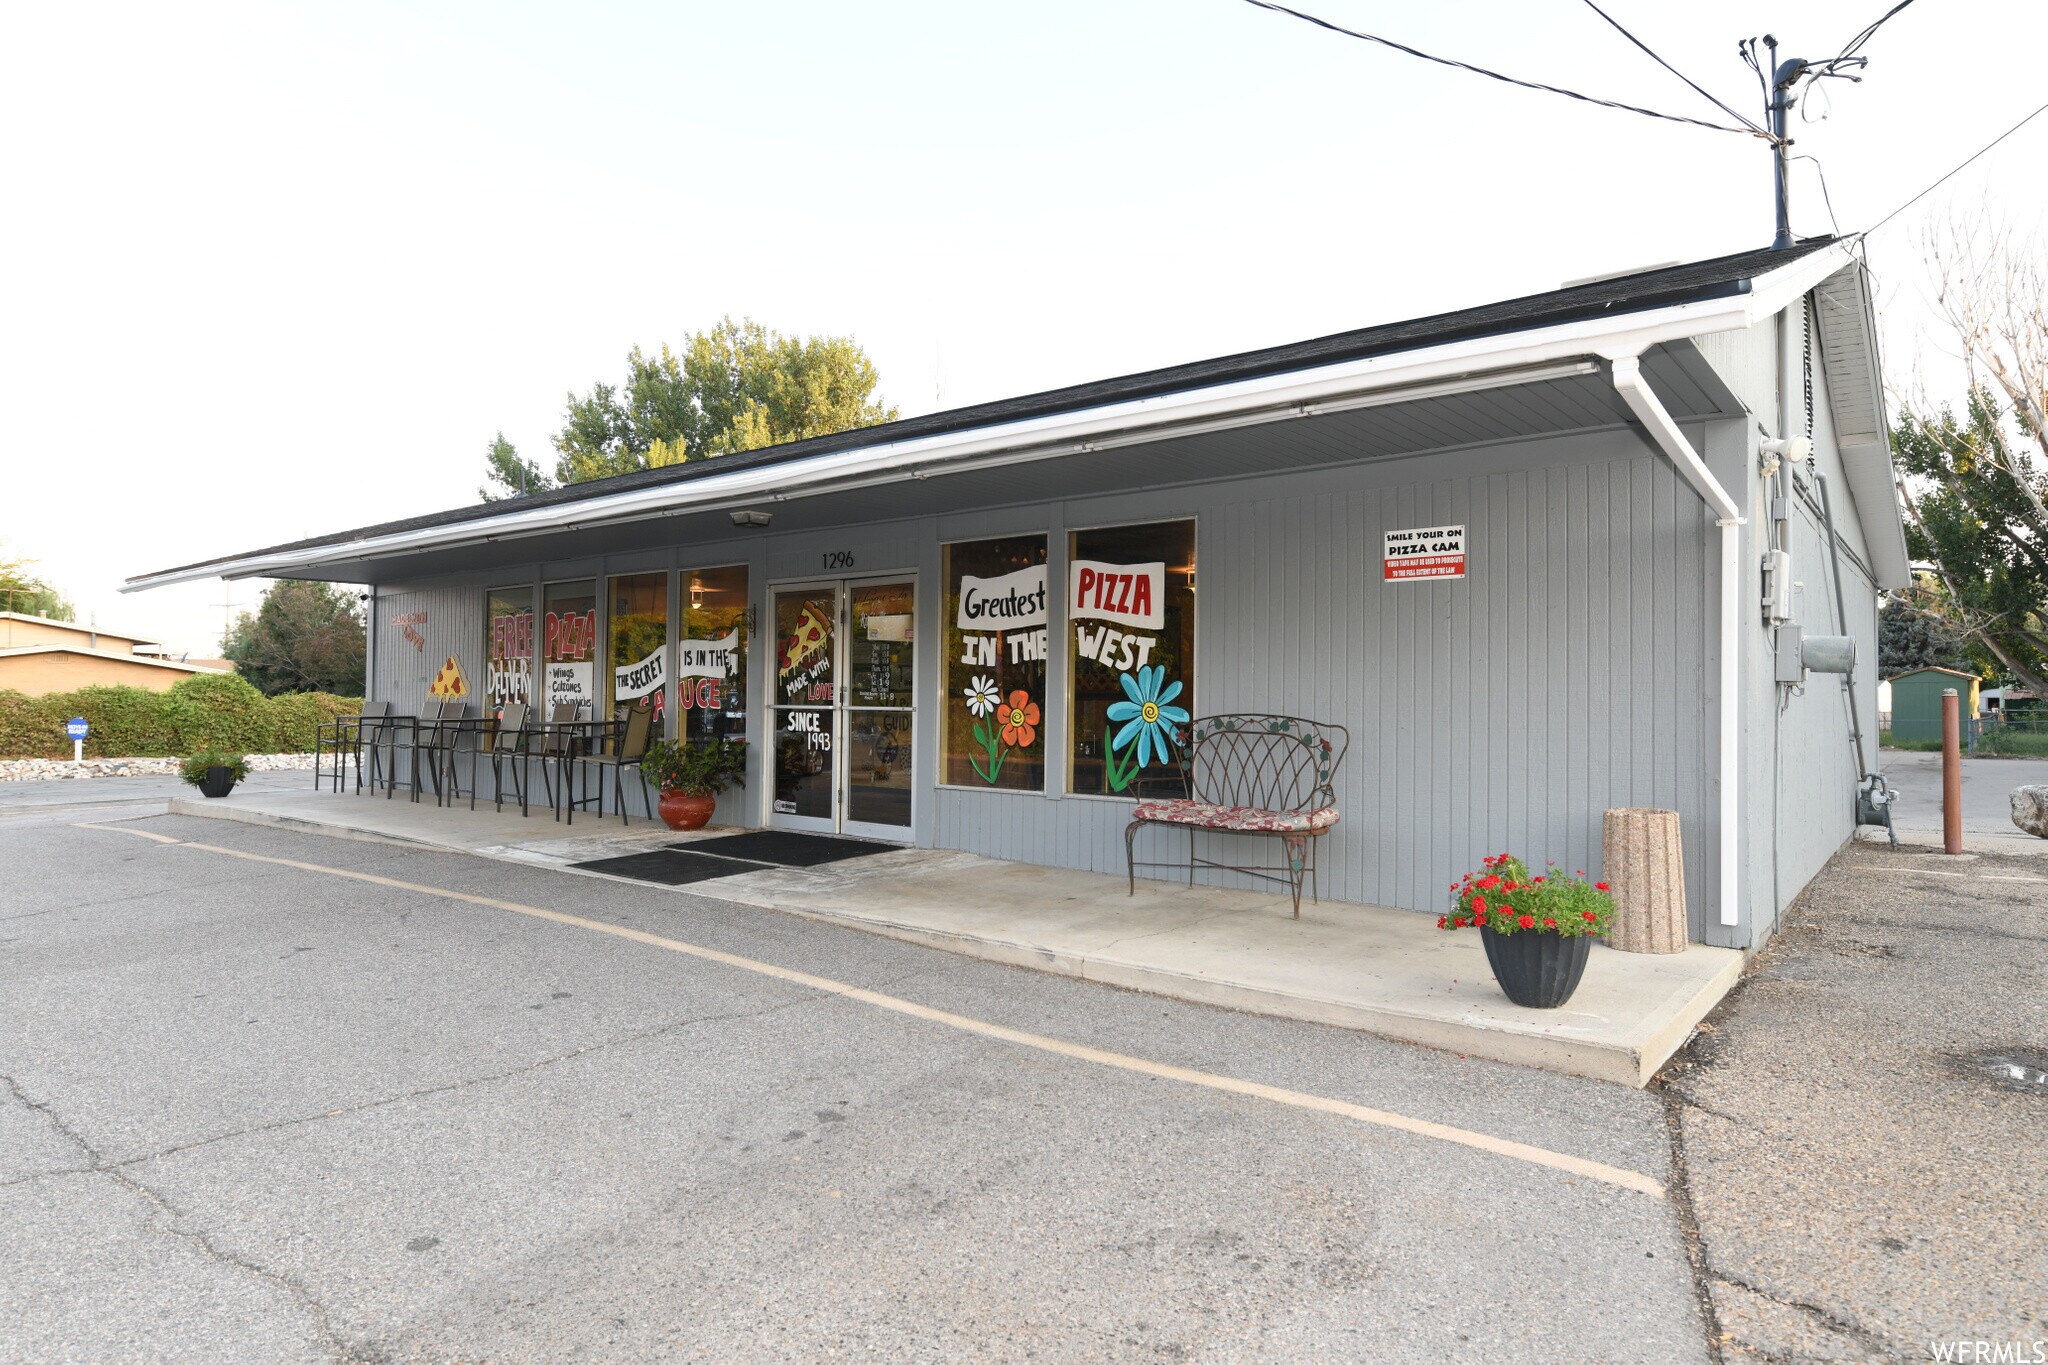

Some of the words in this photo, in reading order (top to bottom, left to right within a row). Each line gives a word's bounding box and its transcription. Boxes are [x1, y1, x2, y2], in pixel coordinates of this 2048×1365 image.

[1387, 533, 1413, 541] SMILE
[1416, 531, 1444, 539] YOUR
[1447, 529, 1462, 537] ON
[1389, 544, 1427, 555] PIZZA
[1431, 541, 1459, 552] CAM
[823, 550, 853, 569] 1296
[964, 580, 1046, 619] Greatest
[1077, 567, 1151, 616] PIZZA
[493, 613, 533, 660] FREE
[545, 608, 596, 660] PIZZA
[961, 634, 997, 667] IN
[1007, 628, 1047, 665] THE
[1077, 625, 1156, 673] WEST
[552, 667, 575, 682] Wings
[616, 673, 629, 688] THE
[630, 654, 662, 690] SECRET
[684, 650, 692, 666] IS
[696, 649, 706, 666] IN
[709, 649, 730, 667] THE
[786, 672, 808, 697] MADE
[808, 657, 830, 679] WITH
[487, 659, 532, 707] DELIVERY
[552, 680, 582, 693] Calzones
[808, 682, 834, 701] LOVE
[787, 711, 820, 732] SINCE
[884, 714, 913, 732] GUID
[807, 732, 831, 751] 1993
